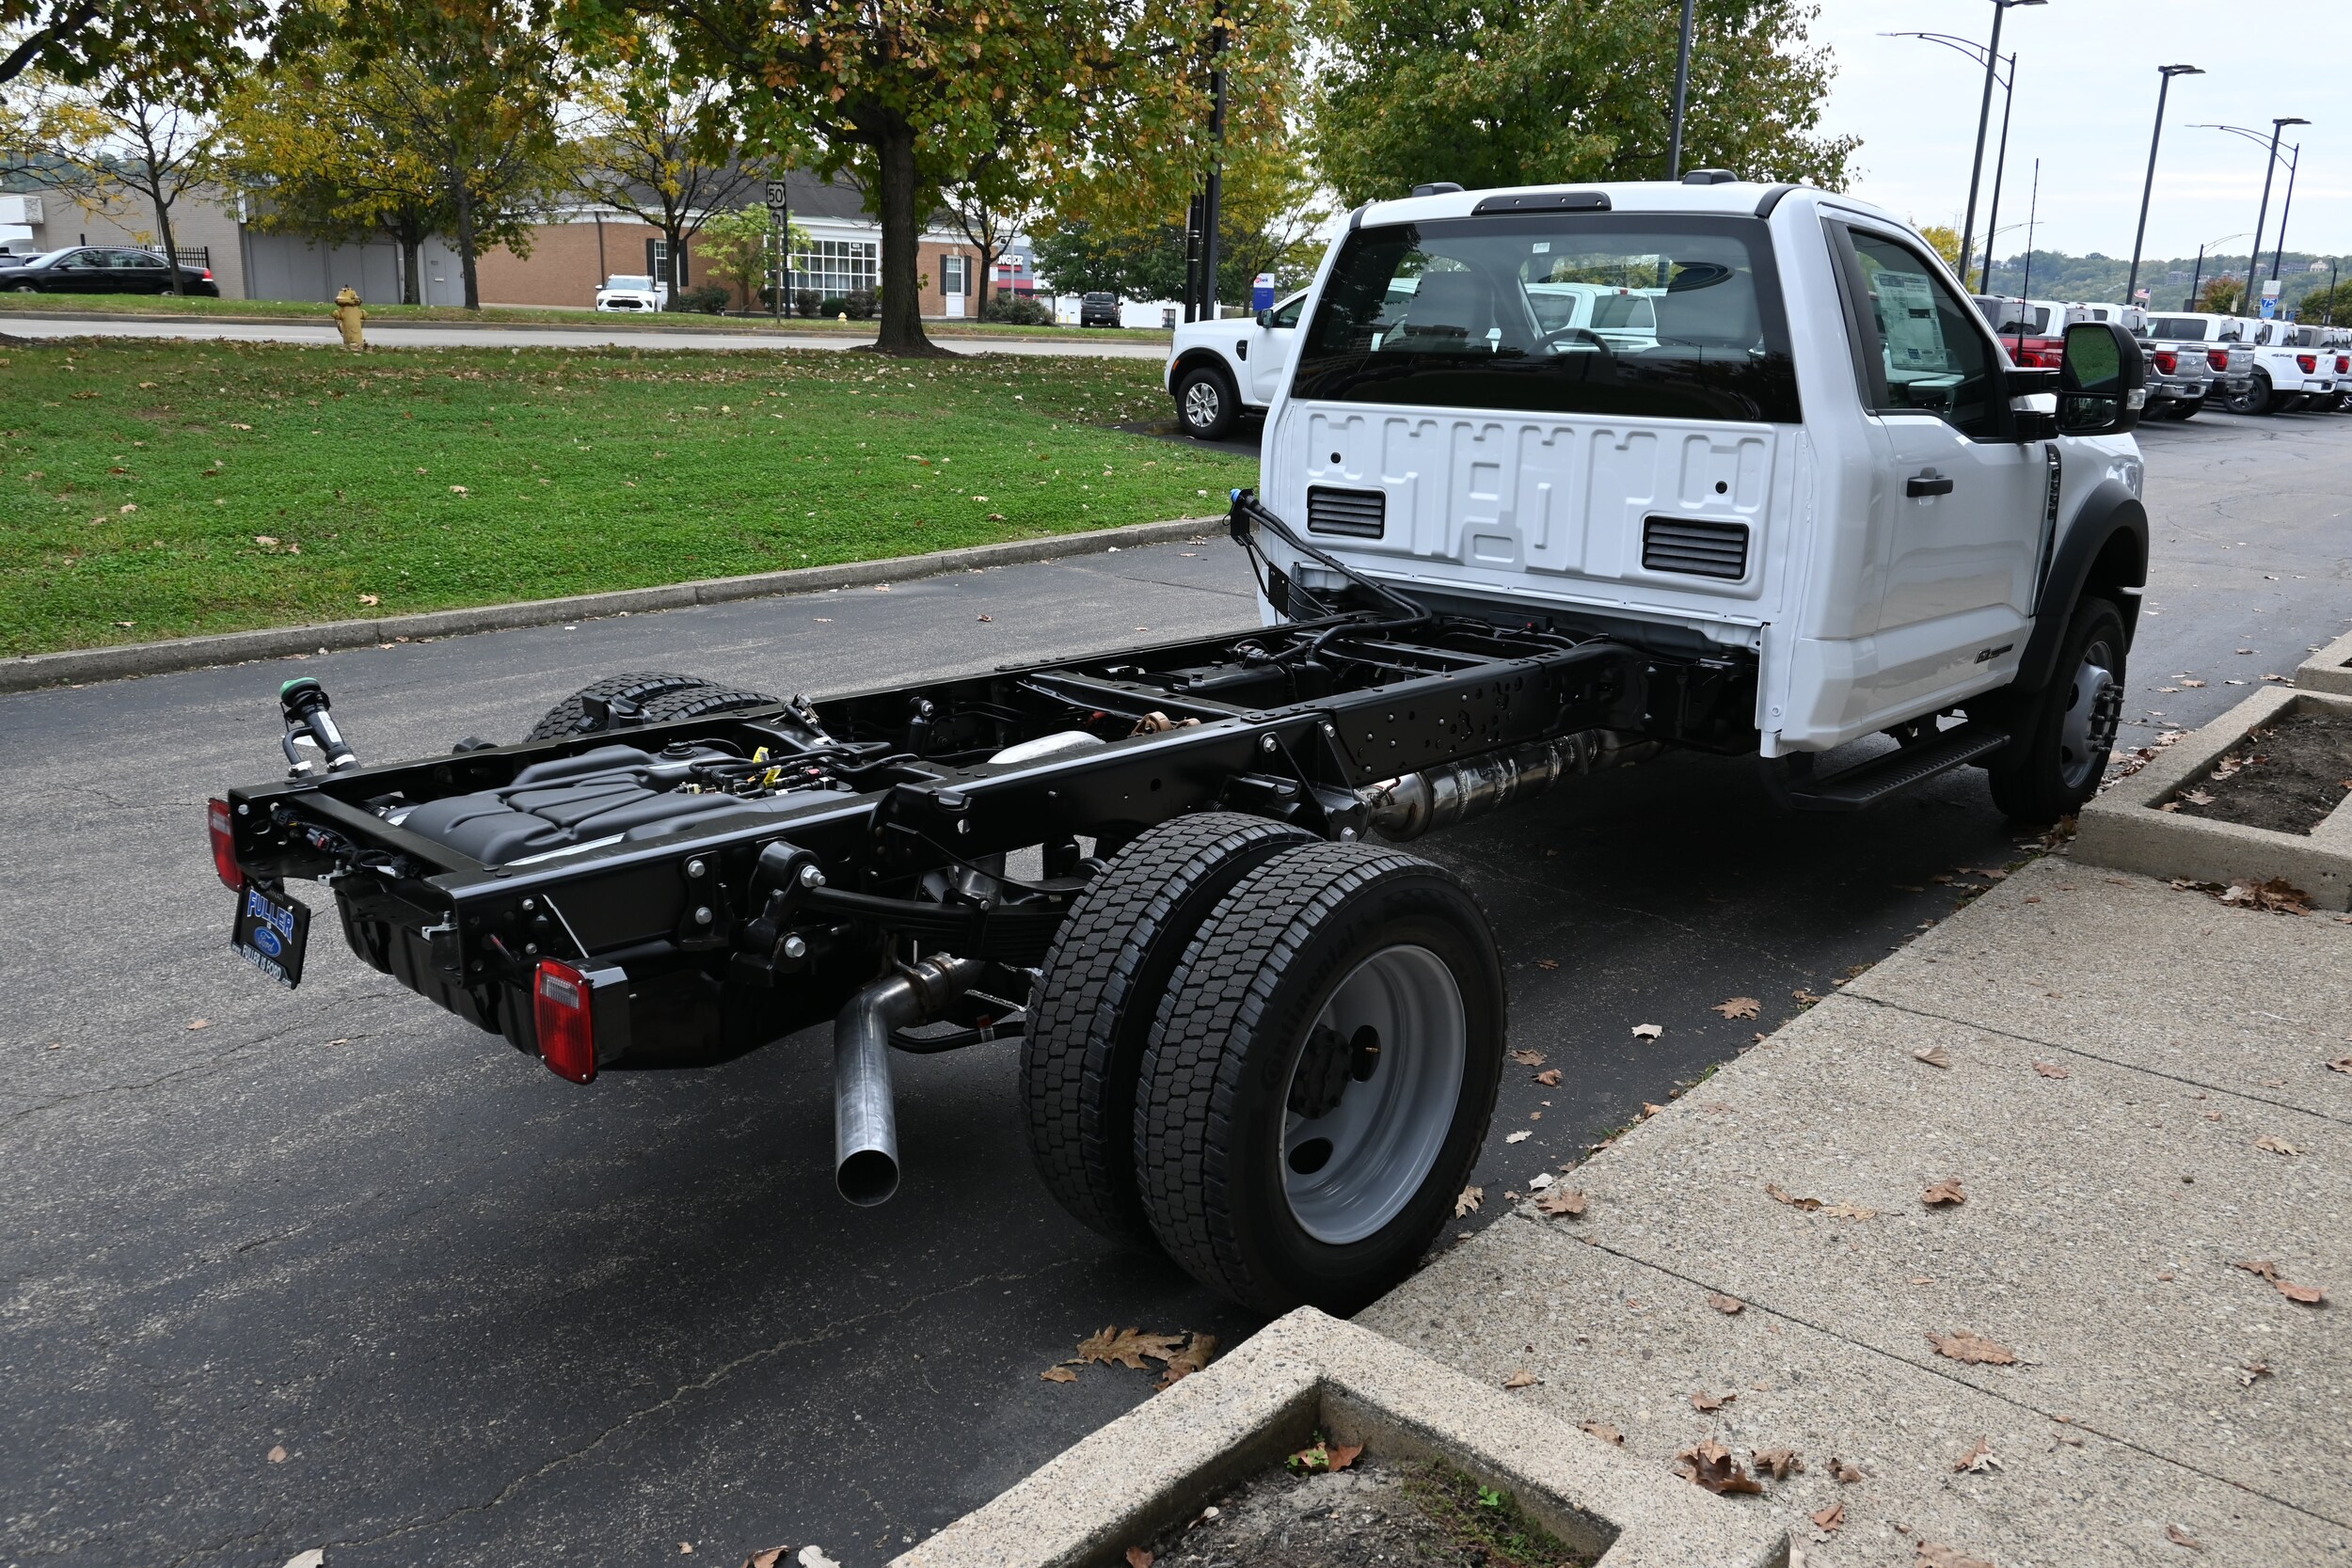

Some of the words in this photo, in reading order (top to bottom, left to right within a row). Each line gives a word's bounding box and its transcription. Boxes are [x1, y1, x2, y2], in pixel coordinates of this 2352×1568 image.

[768, 188, 783, 203] 50
[2263, 298, 2276, 308] 75
[246, 889, 294, 945] FULLER
[242, 943, 261, 967] FULLER
[260, 956, 267, 971] IS
[265, 959, 282, 980] FORD
